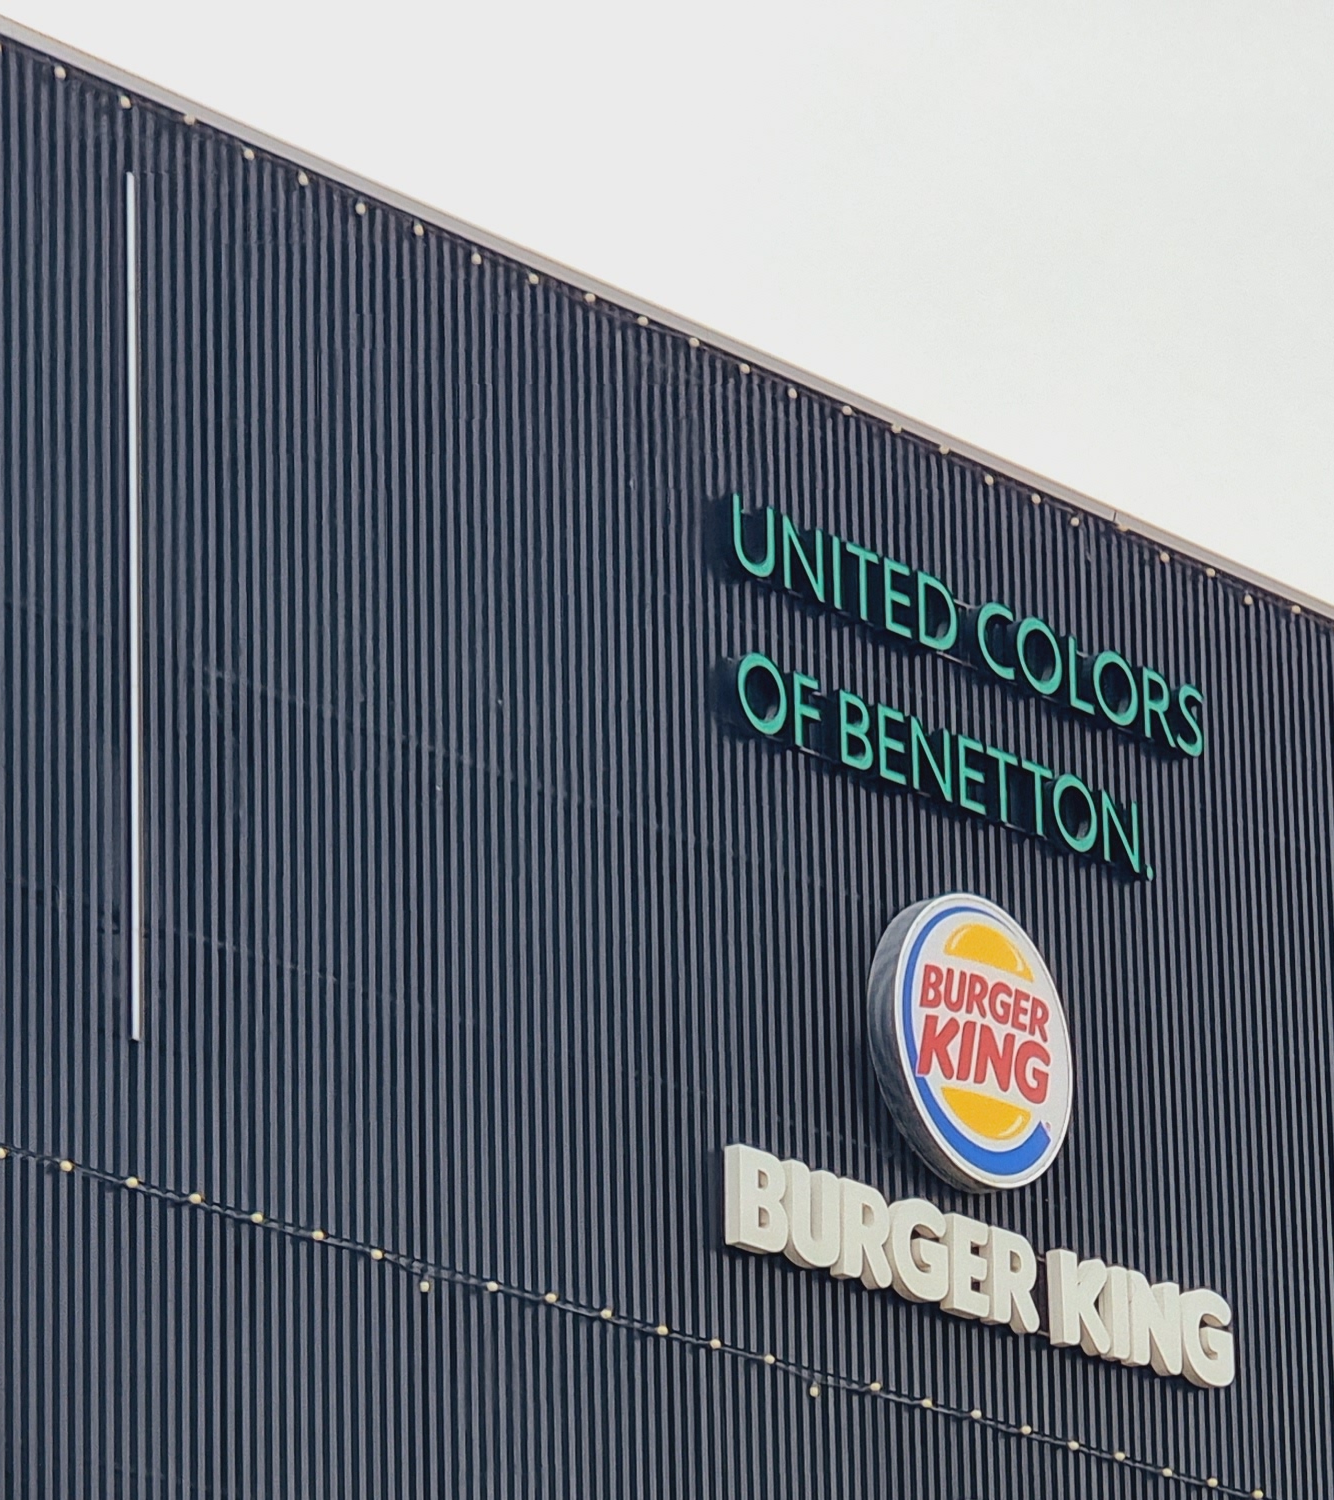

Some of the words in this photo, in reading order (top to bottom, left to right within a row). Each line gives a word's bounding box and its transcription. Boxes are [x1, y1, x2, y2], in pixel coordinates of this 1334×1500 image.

[732, 493, 958, 651] UNITED
[977, 602, 1205, 757] COLORS
[736, 652, 822, 748] OF
[919, 964, 1050, 1042] BURGER
[916, 1014, 1051, 1104] KING
[725, 1144, 1041, 1334] BURGER
[1045, 1248, 1235, 1388] KING
